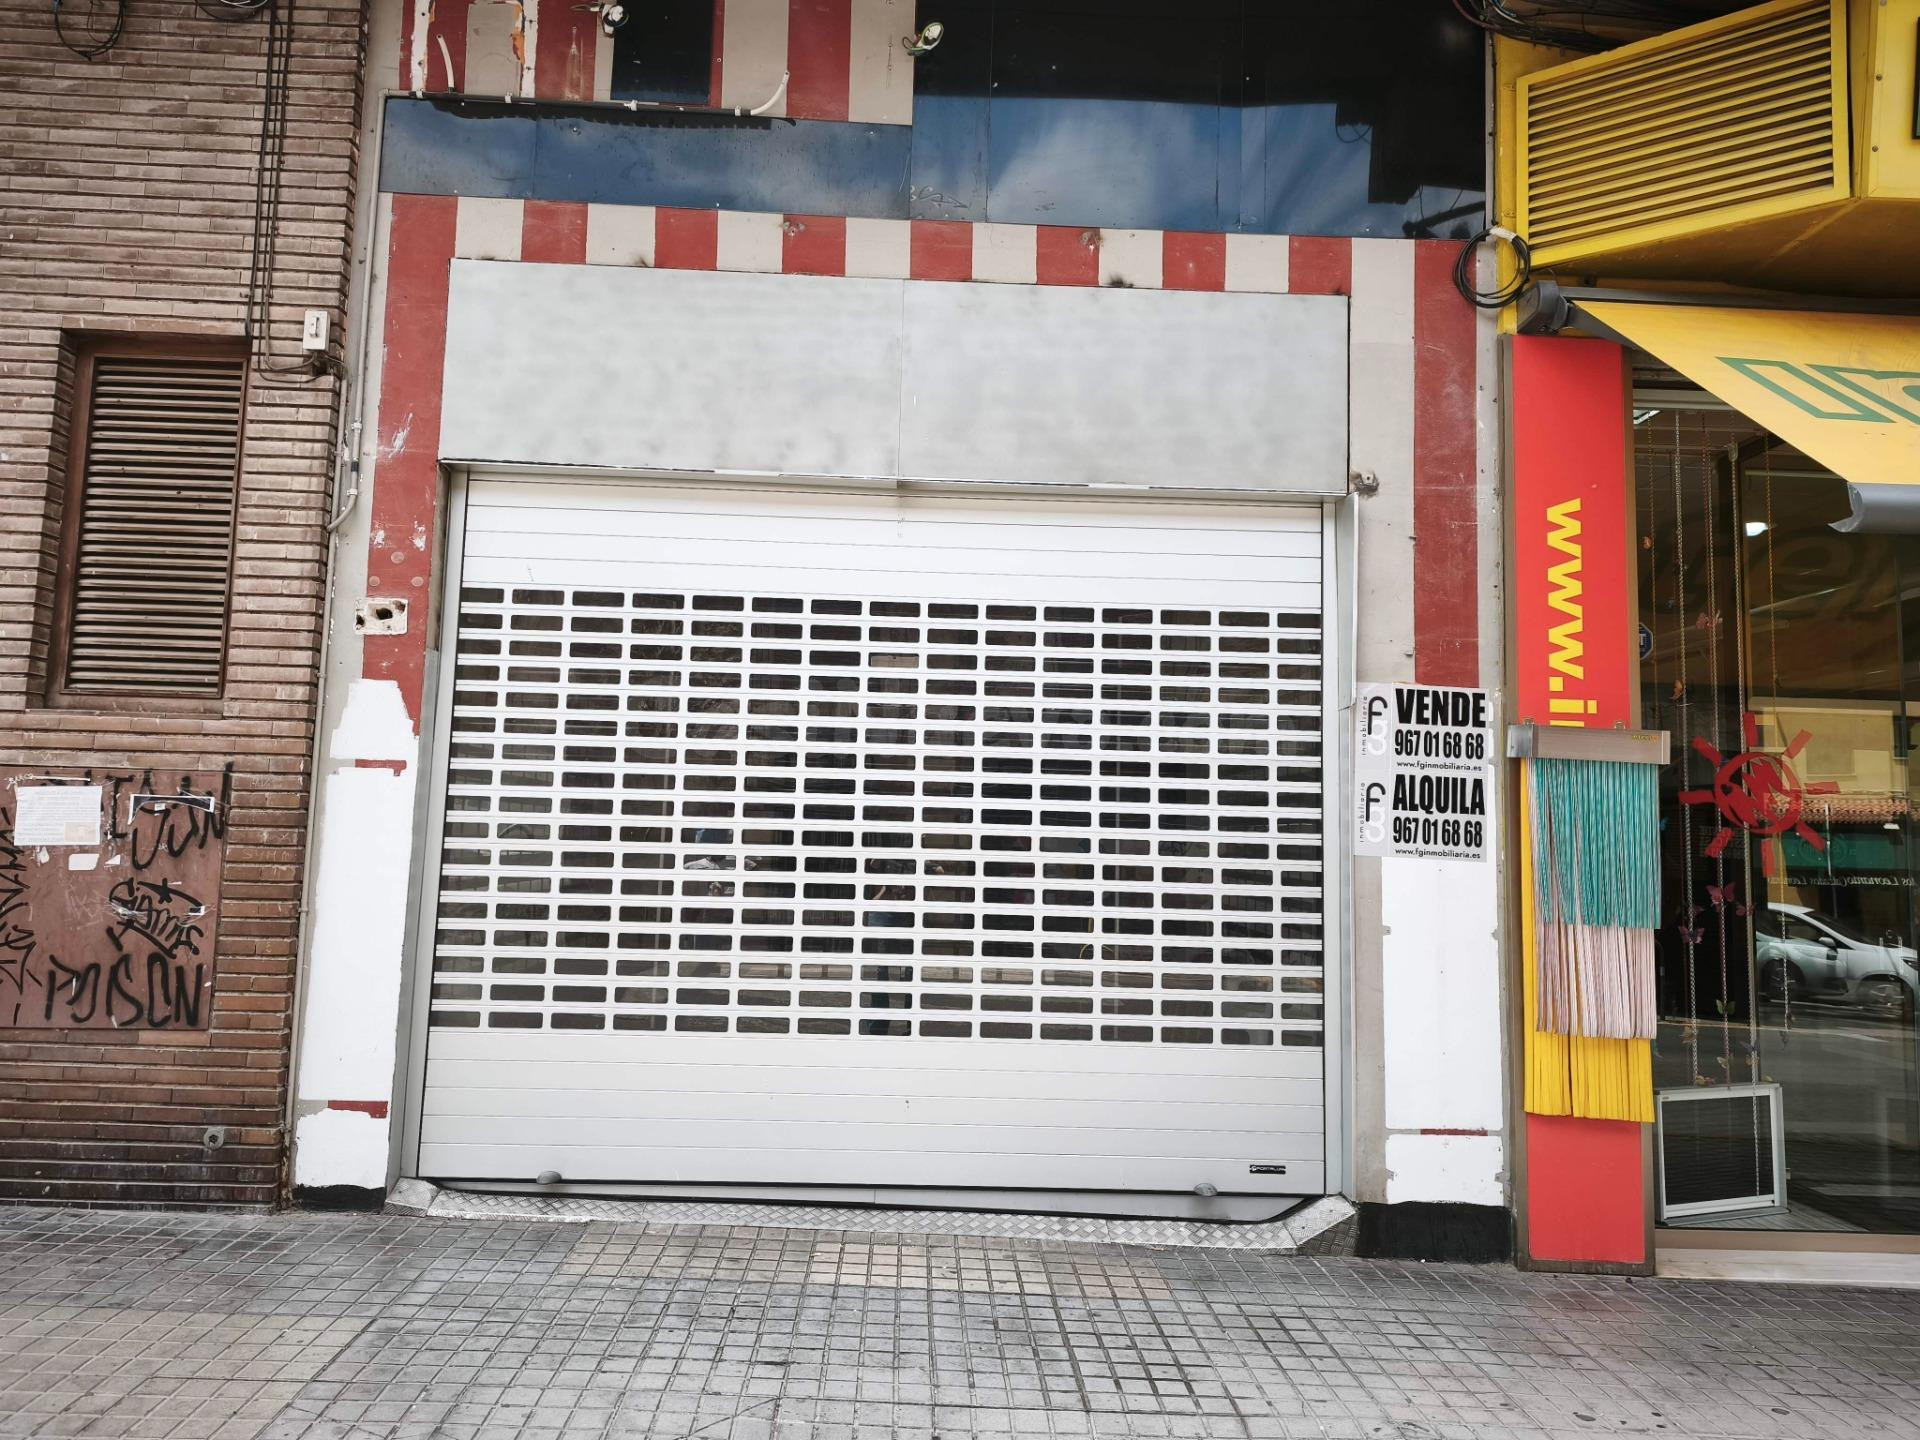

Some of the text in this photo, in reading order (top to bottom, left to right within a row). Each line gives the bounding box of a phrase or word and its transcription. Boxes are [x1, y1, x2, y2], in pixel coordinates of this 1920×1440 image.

[1546, 497, 1598, 728] www.i
[1395, 688, 1486, 728] VENDE
[1394, 729, 1484, 760] 967 01 68 68
[1396, 760, 1482, 771] www.fginmobiliaria.es
[1392, 774, 1486, 815] ALQUILA
[1393, 816, 1483, 848] 967 01 68 68
[1395, 848, 1481, 859] www.fginmobiliaria.es
